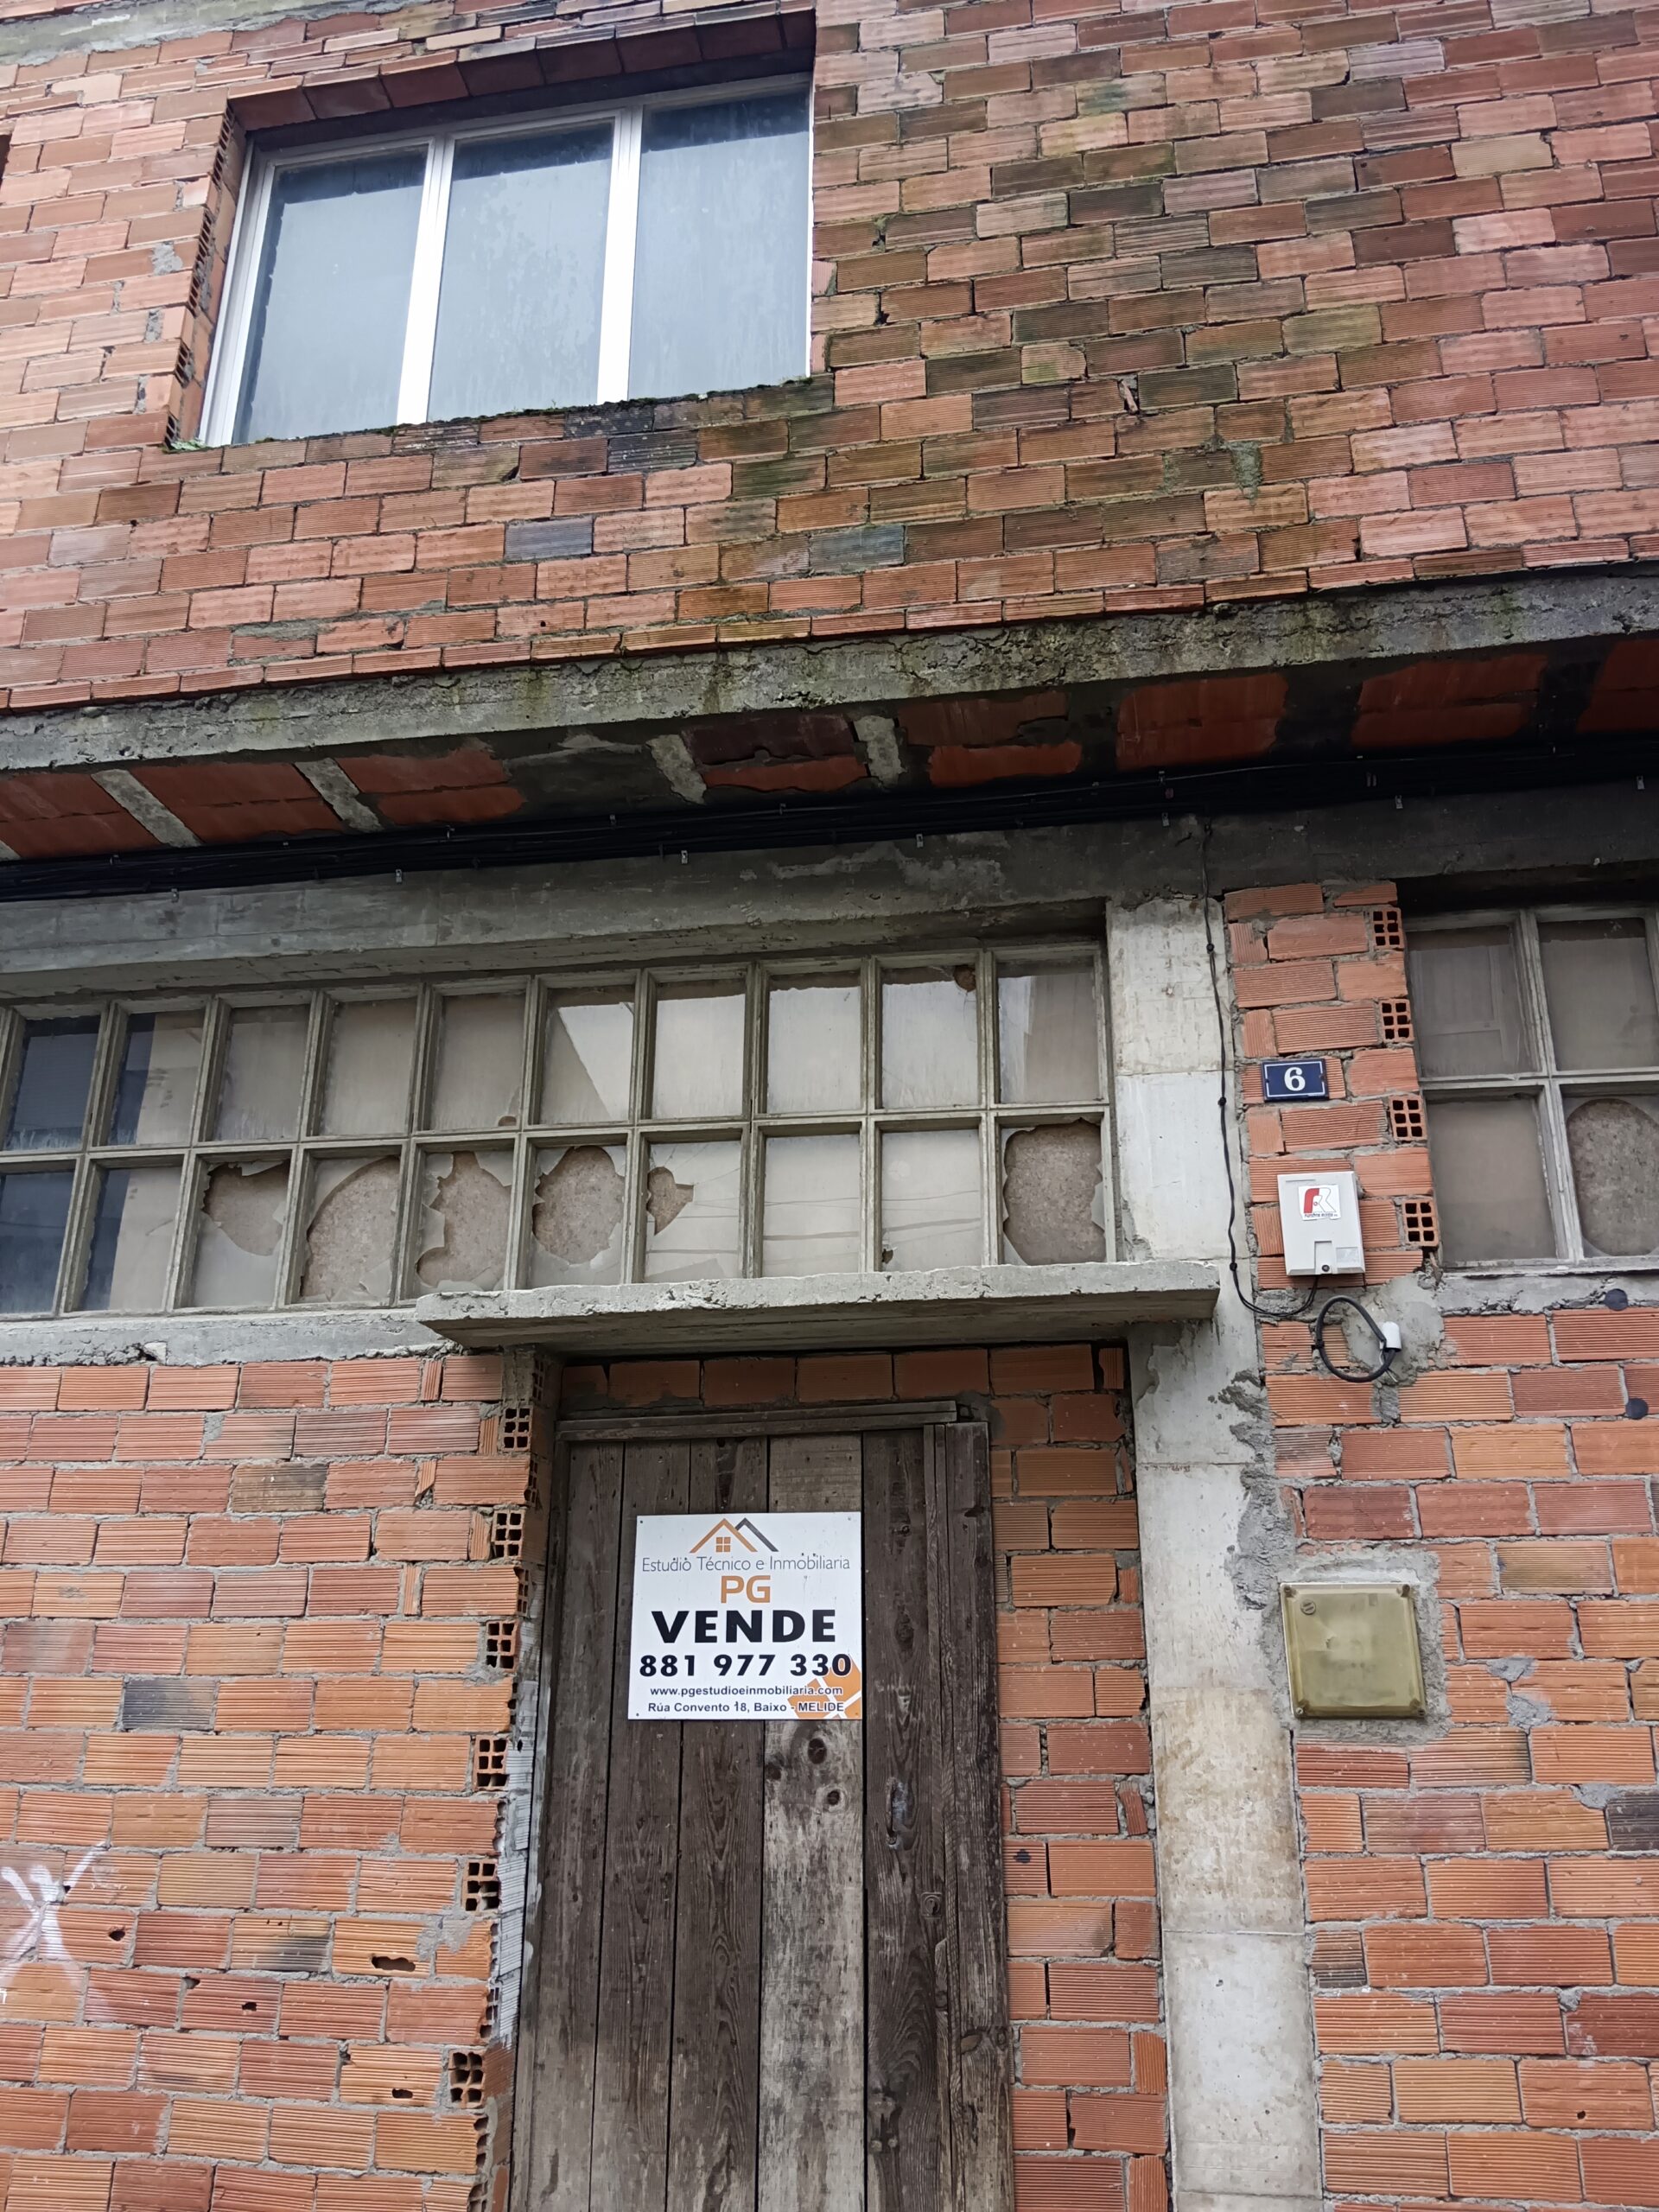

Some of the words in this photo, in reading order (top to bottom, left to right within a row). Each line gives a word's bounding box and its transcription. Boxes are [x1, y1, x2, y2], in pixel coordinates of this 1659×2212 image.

[1284, 1066, 1306, 1091] 6
[642, 1556, 692, 1572] Estudio
[696, 1556, 751, 1571] Técnico
[755, 1560, 765, 1570] e
[770, 1555, 850, 1570] Inmobiliaria
[721, 1575, 771, 1604] PG
[651, 1610, 836, 1643] VENDE
[639, 1655, 695, 1677] 881
[714, 1654, 776, 1676] 977
[790, 1654, 852, 1676] 330
[650, 1686, 842, 1698] www.pgestudioeinmobiliaria.com
[648, 1702, 671, 1712] Rúa
[674, 1702, 730, 1713] Convento
[734, 1701, 750, 1713] 18,
[753, 1702, 787, 1712] Baixo
[798, 1702, 844, 1712] MELIDE
